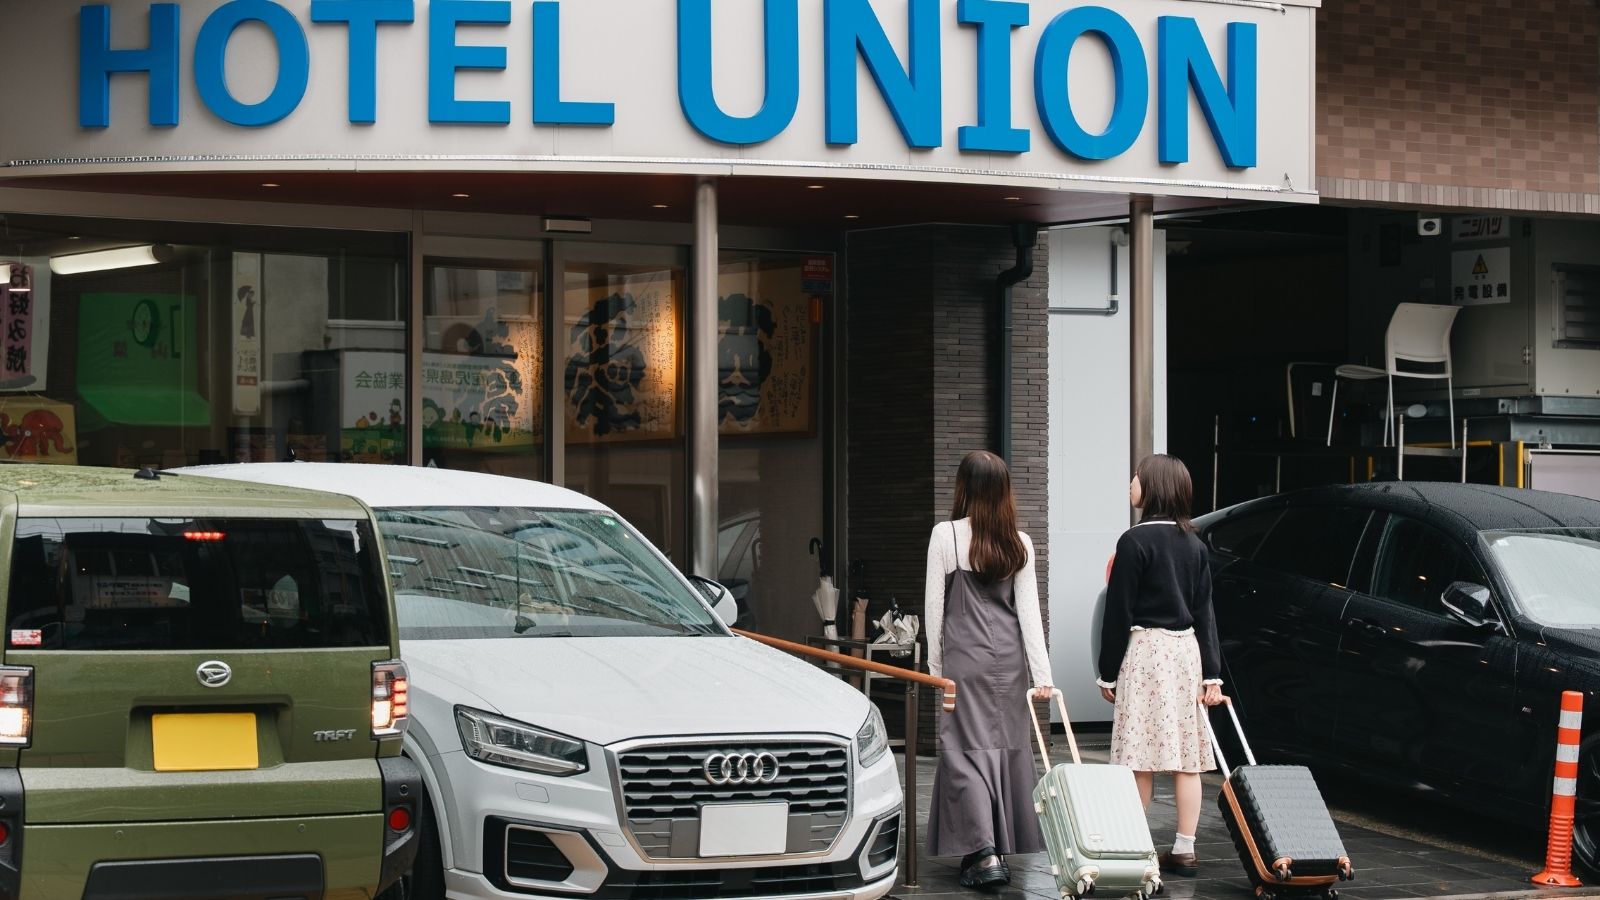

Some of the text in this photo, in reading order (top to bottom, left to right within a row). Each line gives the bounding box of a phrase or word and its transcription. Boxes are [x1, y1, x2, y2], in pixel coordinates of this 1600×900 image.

[79, 0, 1257, 169] HOTEL UNION
[1459, 216, 1502, 237] ニシハツ
[313, 729, 357, 741] TAFT
